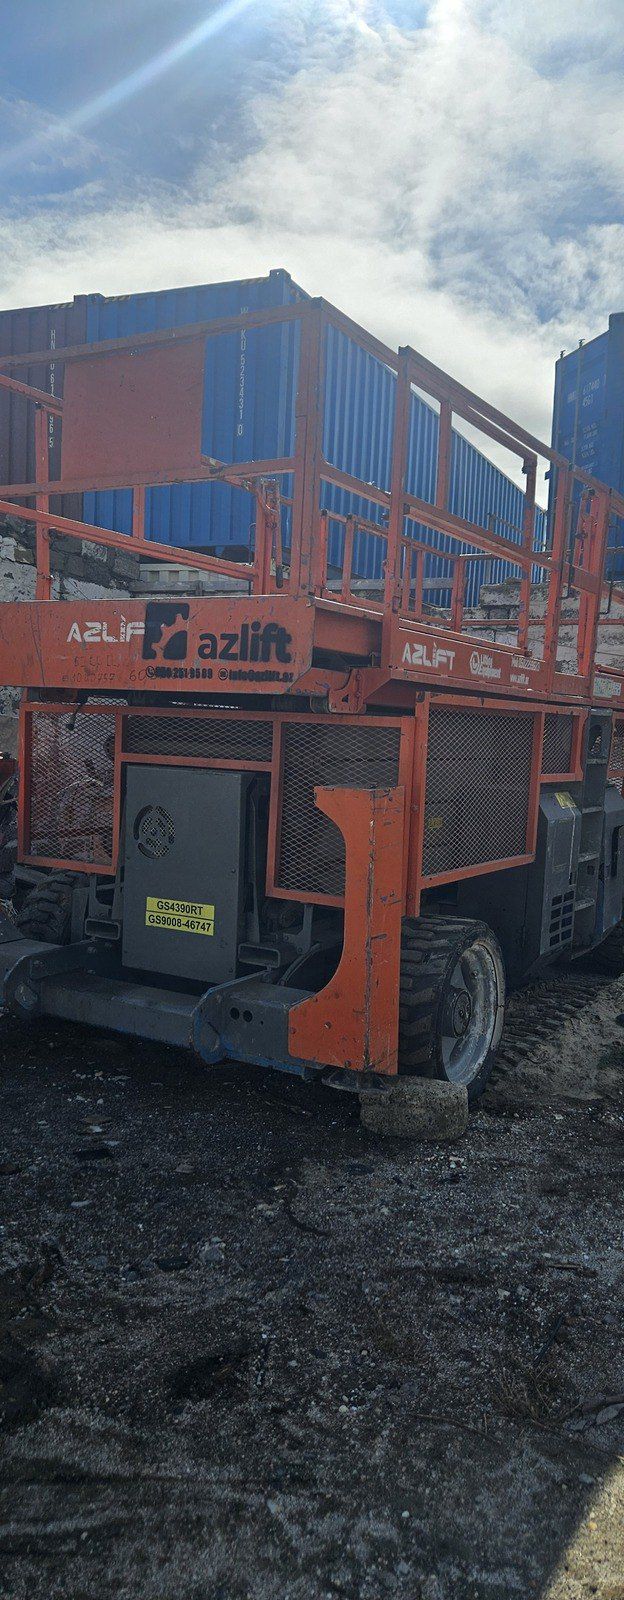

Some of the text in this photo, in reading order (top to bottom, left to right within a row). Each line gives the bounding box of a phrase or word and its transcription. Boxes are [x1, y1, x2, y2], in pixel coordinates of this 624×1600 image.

[197, 621, 293, 664] azlift
[156, 900, 203, 916] GS4390RT
[148, 914, 212, 932] GS9008-46747
